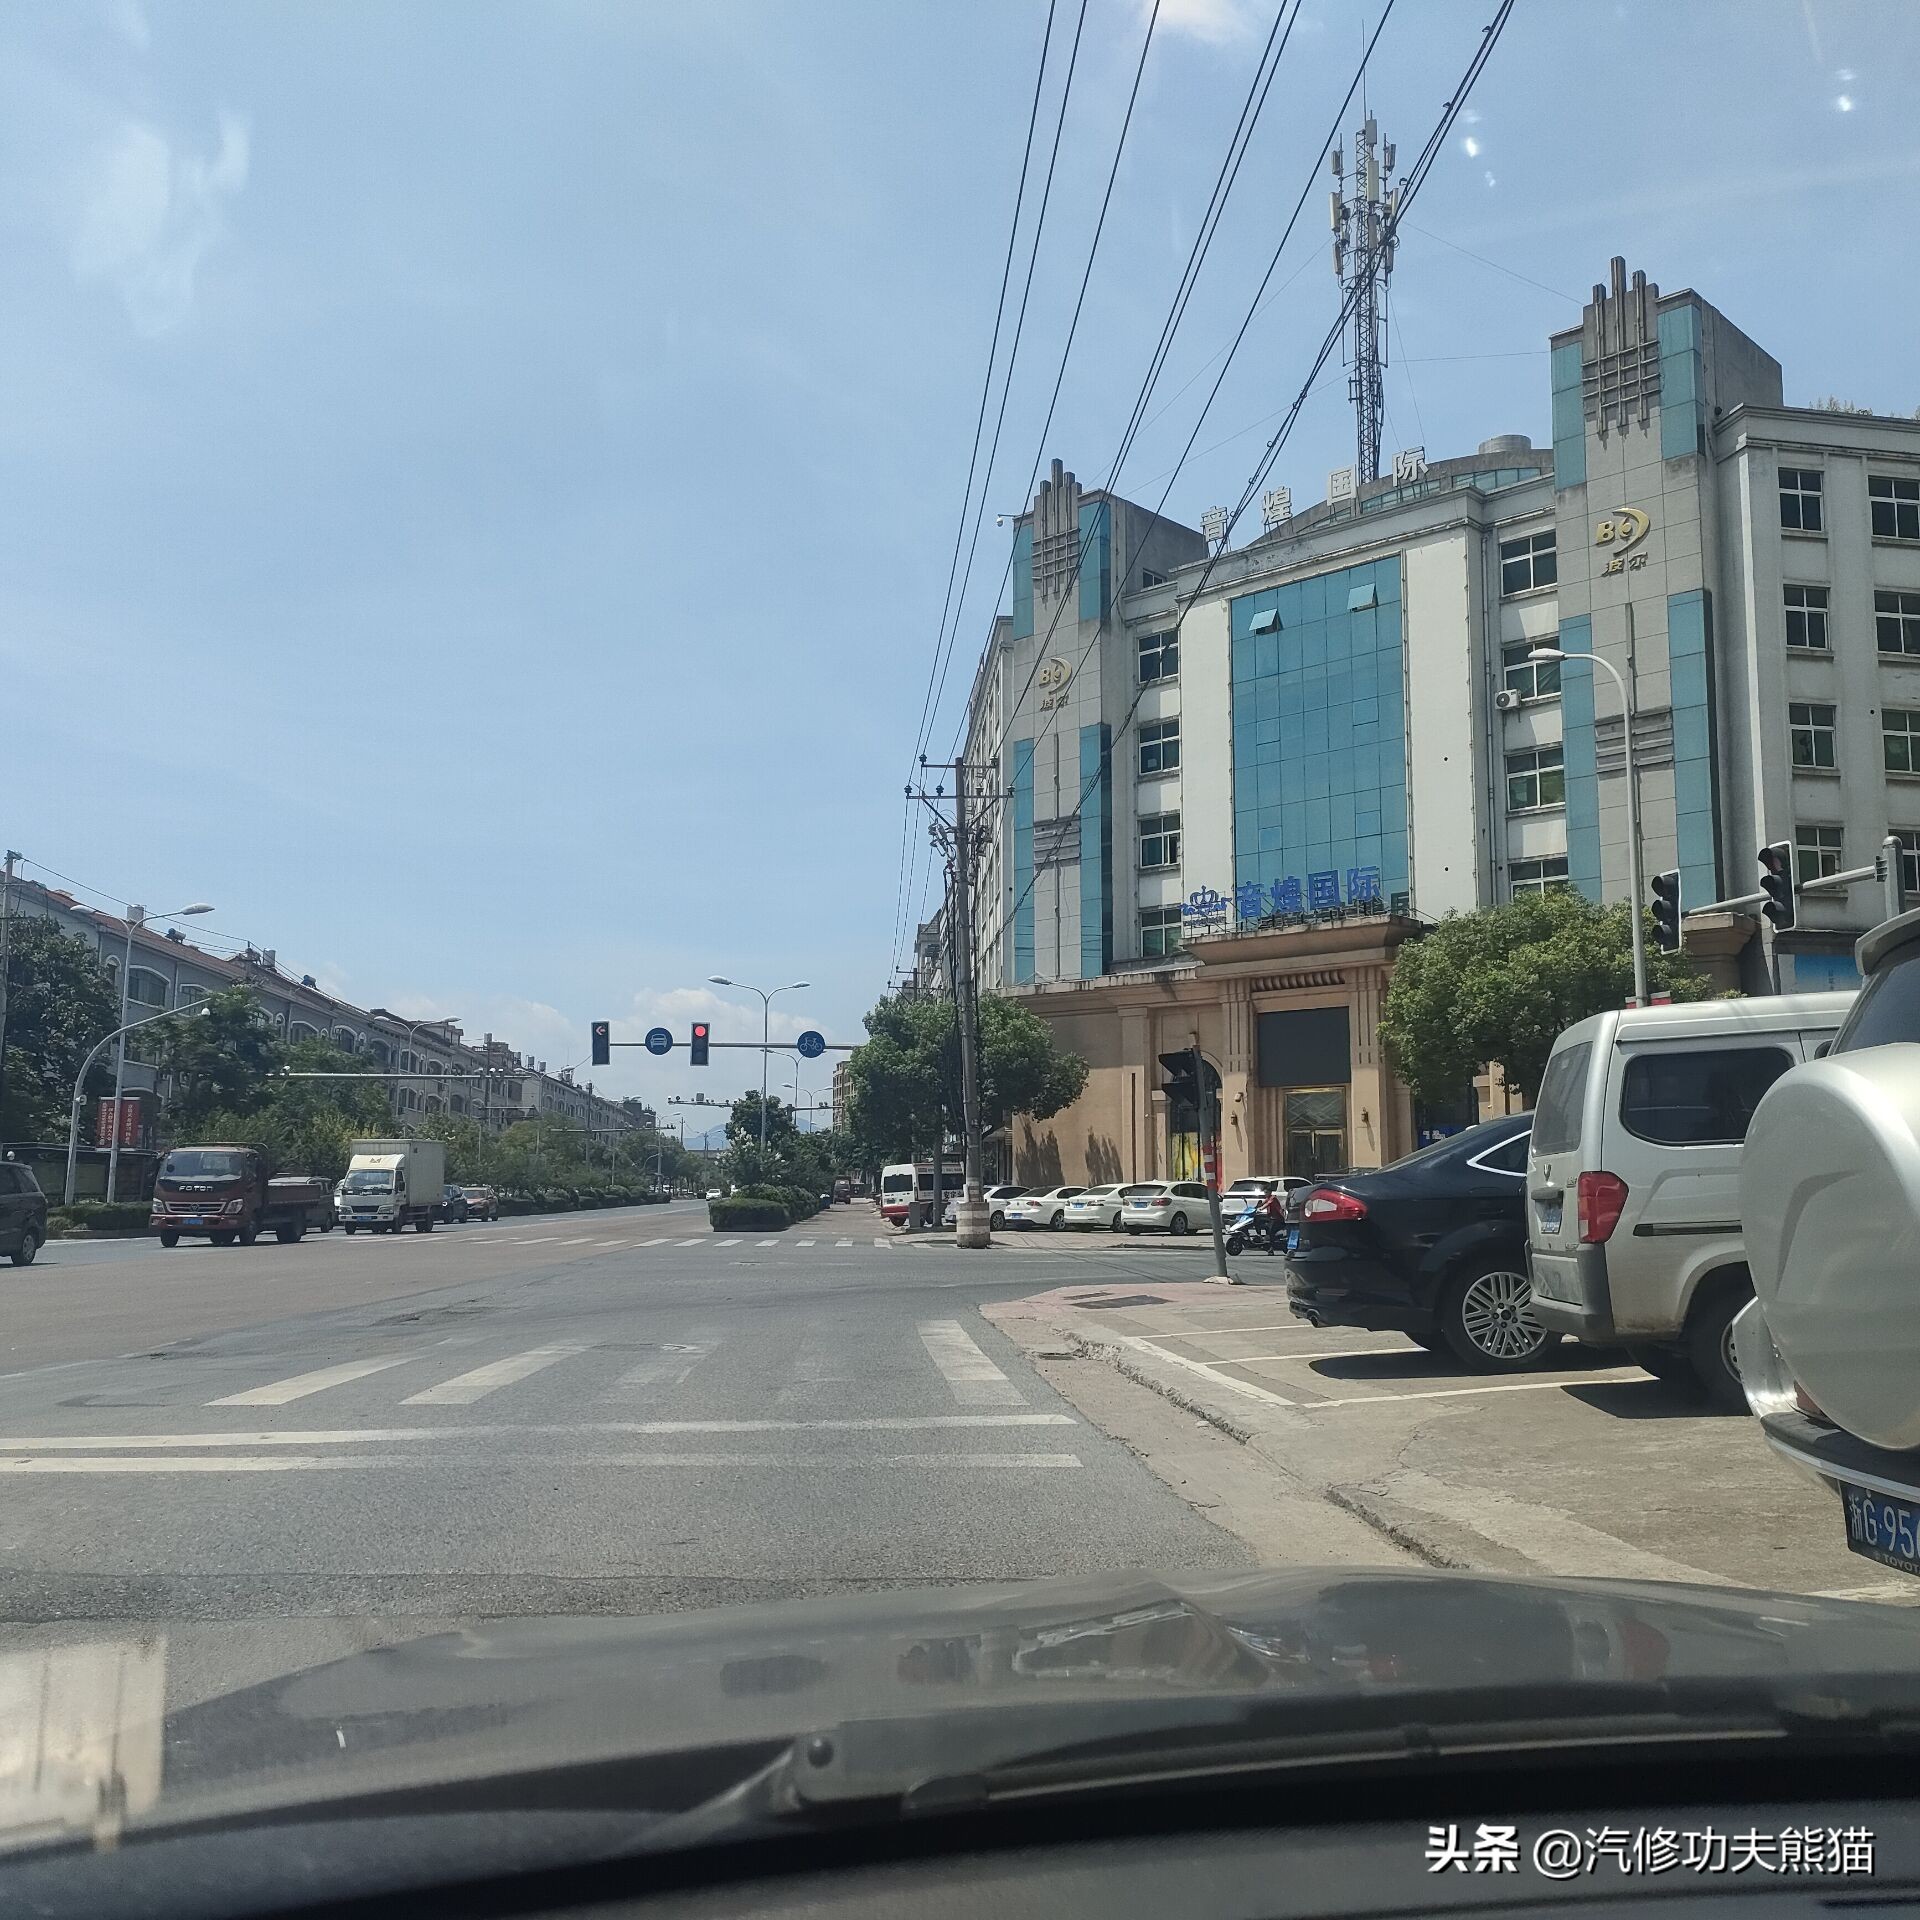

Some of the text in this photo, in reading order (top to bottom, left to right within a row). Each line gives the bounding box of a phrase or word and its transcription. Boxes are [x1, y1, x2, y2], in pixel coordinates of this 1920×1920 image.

[1200, 446, 1428, 542] 音煌国际
[1236, 866, 1381, 918] 音煌国际
[1882, 1552, 1920, 1577] TOYOT
